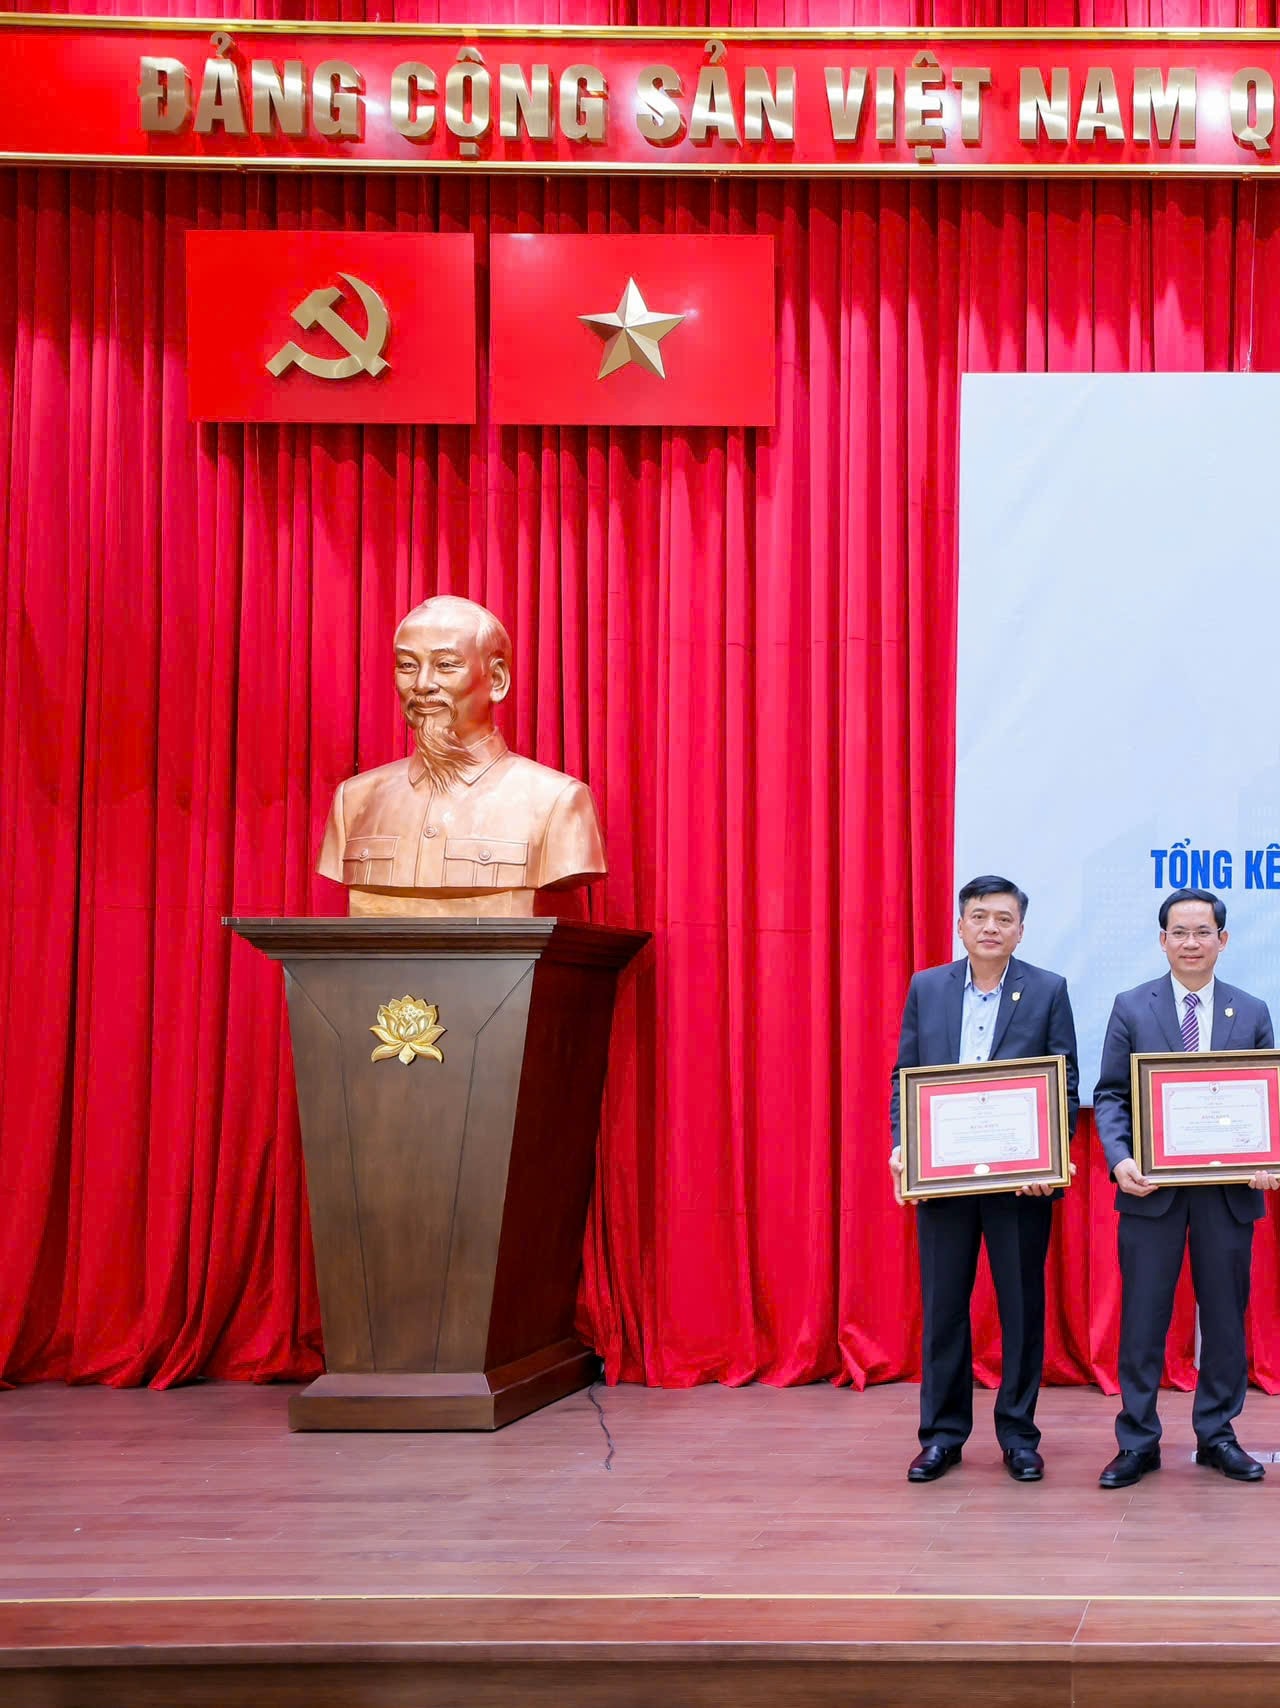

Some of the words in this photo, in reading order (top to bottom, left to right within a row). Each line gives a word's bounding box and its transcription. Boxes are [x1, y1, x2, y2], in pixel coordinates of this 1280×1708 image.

[139, 31, 366, 142] ĐẢNG
[390, 46, 607, 160] CỘNG
[636, 39, 796, 147] SẢN
[824, 50, 992, 162] VIỆT
[1019, 67, 1197, 144] NAM
[1151, 838, 1233, 890] TỔNG
